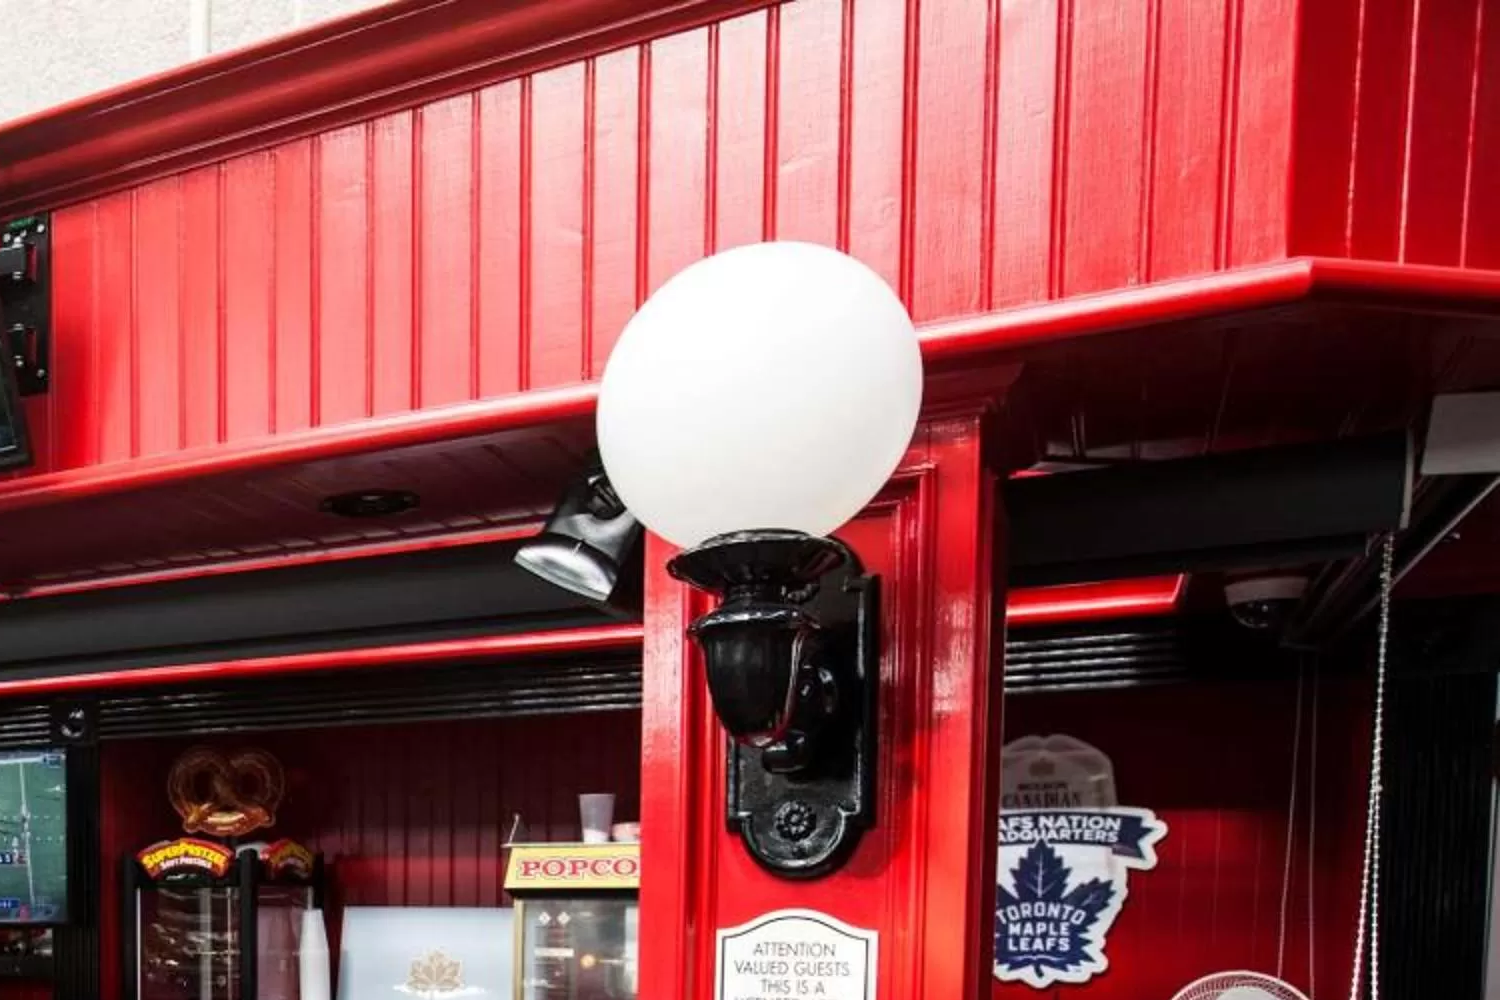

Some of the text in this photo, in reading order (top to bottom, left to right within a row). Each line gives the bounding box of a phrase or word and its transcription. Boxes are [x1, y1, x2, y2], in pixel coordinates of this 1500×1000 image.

[1038, 815, 1122, 832] NATION
[519, 856, 639, 879] POPCO
[996, 901, 1087, 925] TORONTO
[1007, 922, 1071, 936] MAPLE
[752, 942, 837, 958] ATTENTION
[1007, 937, 1071, 952] LEAFS
[733, 960, 850, 977] VALUED GUESTS
[760, 979, 826, 995] THIS IS A
